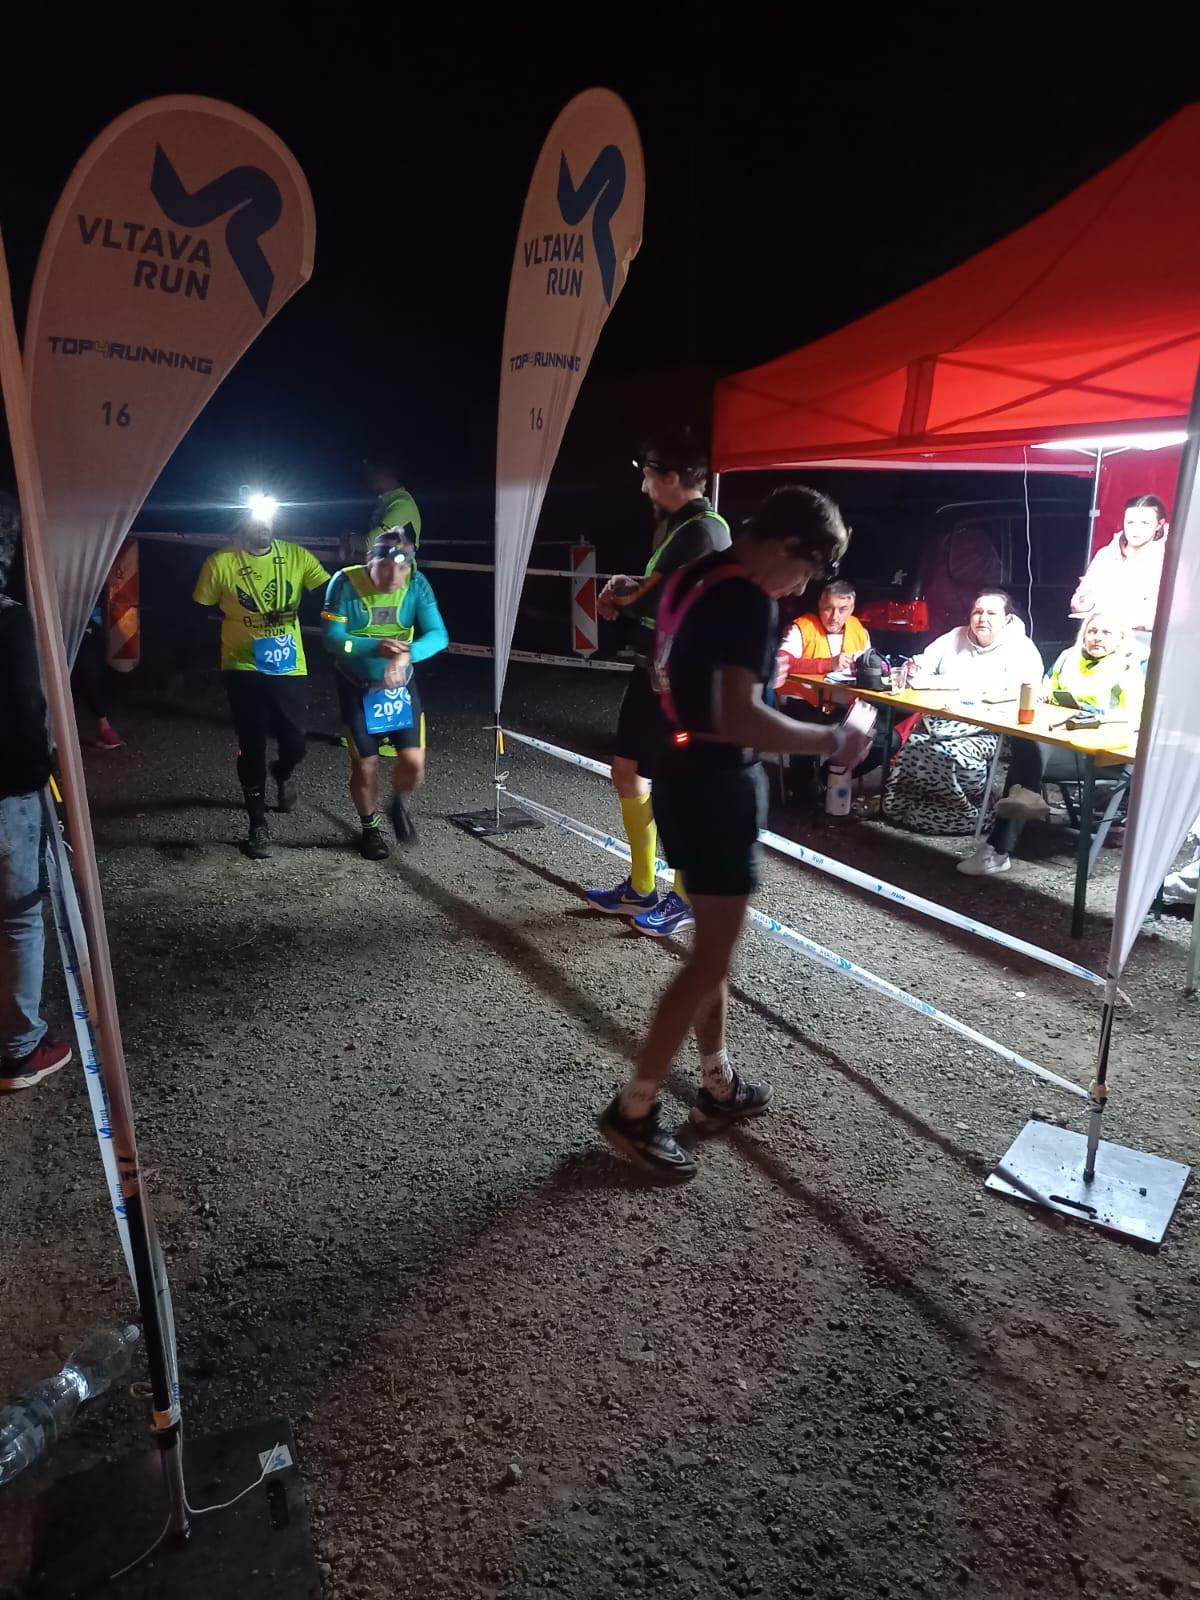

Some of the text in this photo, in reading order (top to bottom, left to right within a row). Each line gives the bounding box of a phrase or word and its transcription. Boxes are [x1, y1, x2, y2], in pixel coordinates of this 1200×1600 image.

[78, 214, 212, 269] VLTAVA
[523, 234, 584, 268] VLTAVA
[134, 259, 211, 301] RUN
[546, 267, 583, 298] RUN
[102, 401, 131, 427] 16
[530, 407, 544, 431] 16
[264, 646, 291, 663] 209
[373, 700, 404, 718] 209
